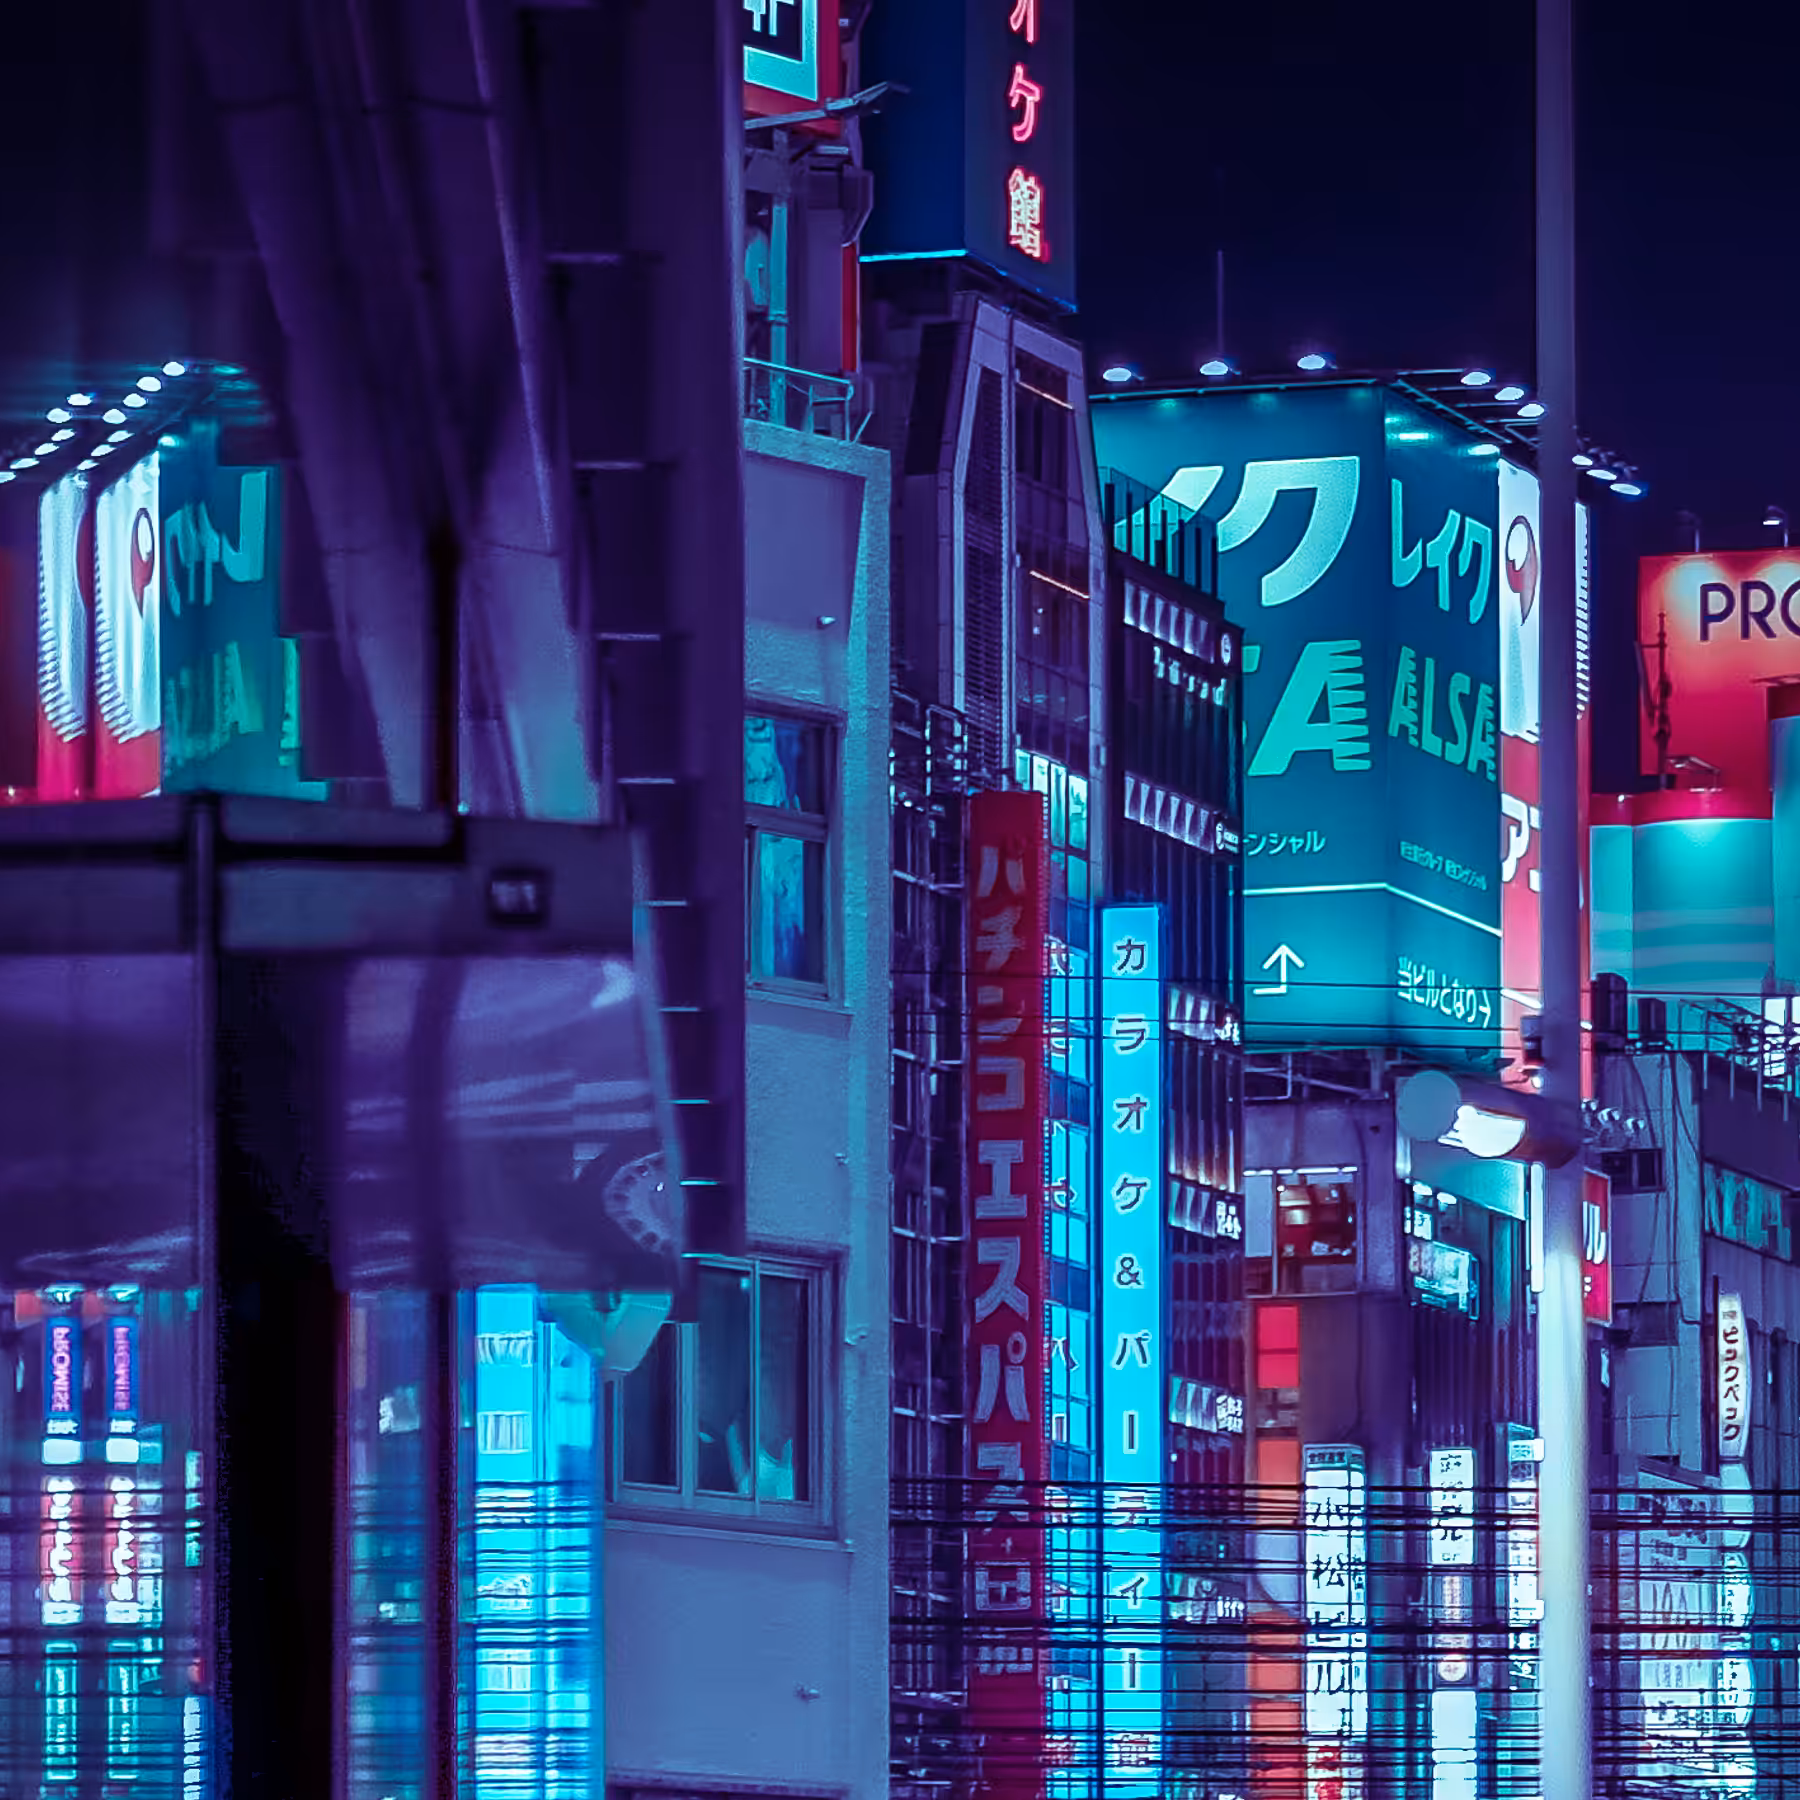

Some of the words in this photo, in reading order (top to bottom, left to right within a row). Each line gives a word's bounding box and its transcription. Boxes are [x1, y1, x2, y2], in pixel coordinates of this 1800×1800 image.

[1390, 477, 1493, 625] レイク
[1390, 645, 1497, 782] ALSA
